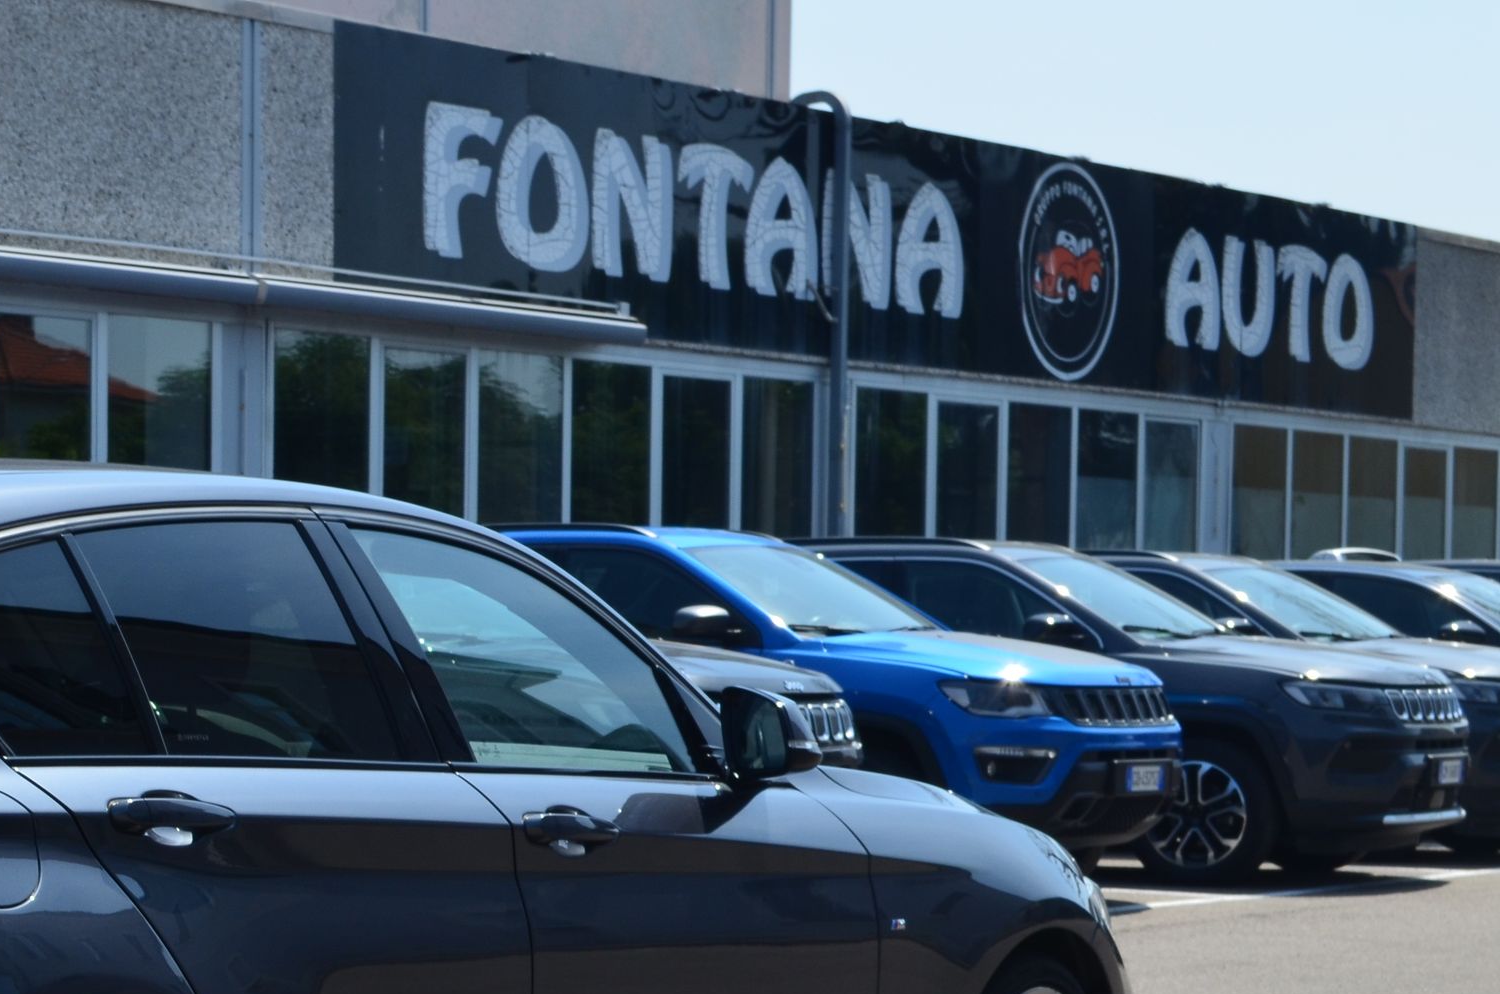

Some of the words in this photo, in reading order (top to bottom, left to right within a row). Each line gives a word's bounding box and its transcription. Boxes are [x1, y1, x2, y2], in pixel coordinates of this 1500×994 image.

[422, 101, 964, 319] FONTANA
[1165, 227, 1374, 370] AUTO
[1062, 180, 1098, 218] FONTANA
